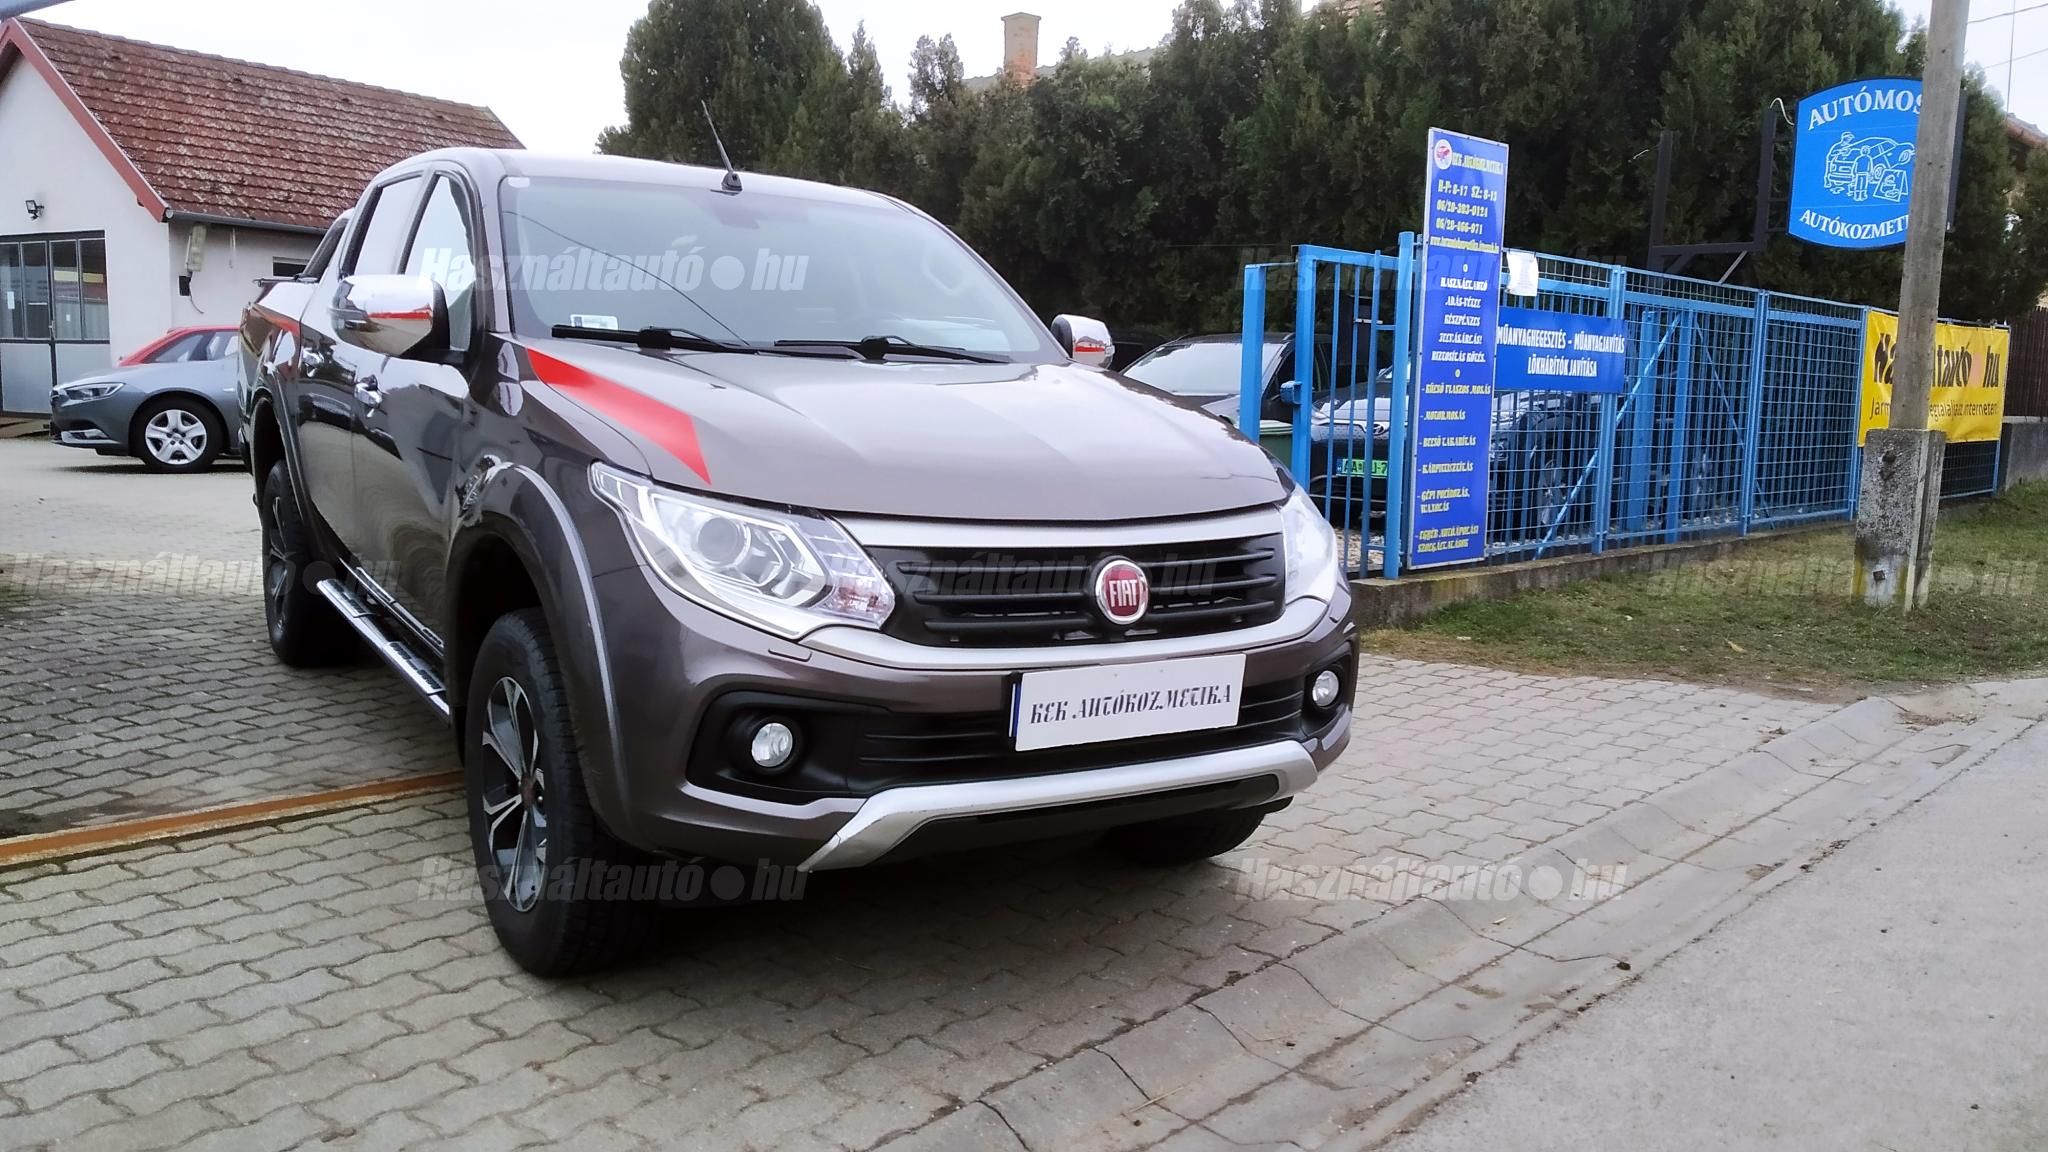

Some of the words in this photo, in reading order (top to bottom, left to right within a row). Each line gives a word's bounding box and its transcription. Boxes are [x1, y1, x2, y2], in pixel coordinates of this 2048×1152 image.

[1808, 86, 1922, 131] AUTÓMOS
[1800, 209, 1909, 239] AUTÓKOZMETI
[1109, 579, 1137, 607] FIAT
[1030, 701, 1068, 724] KEK
